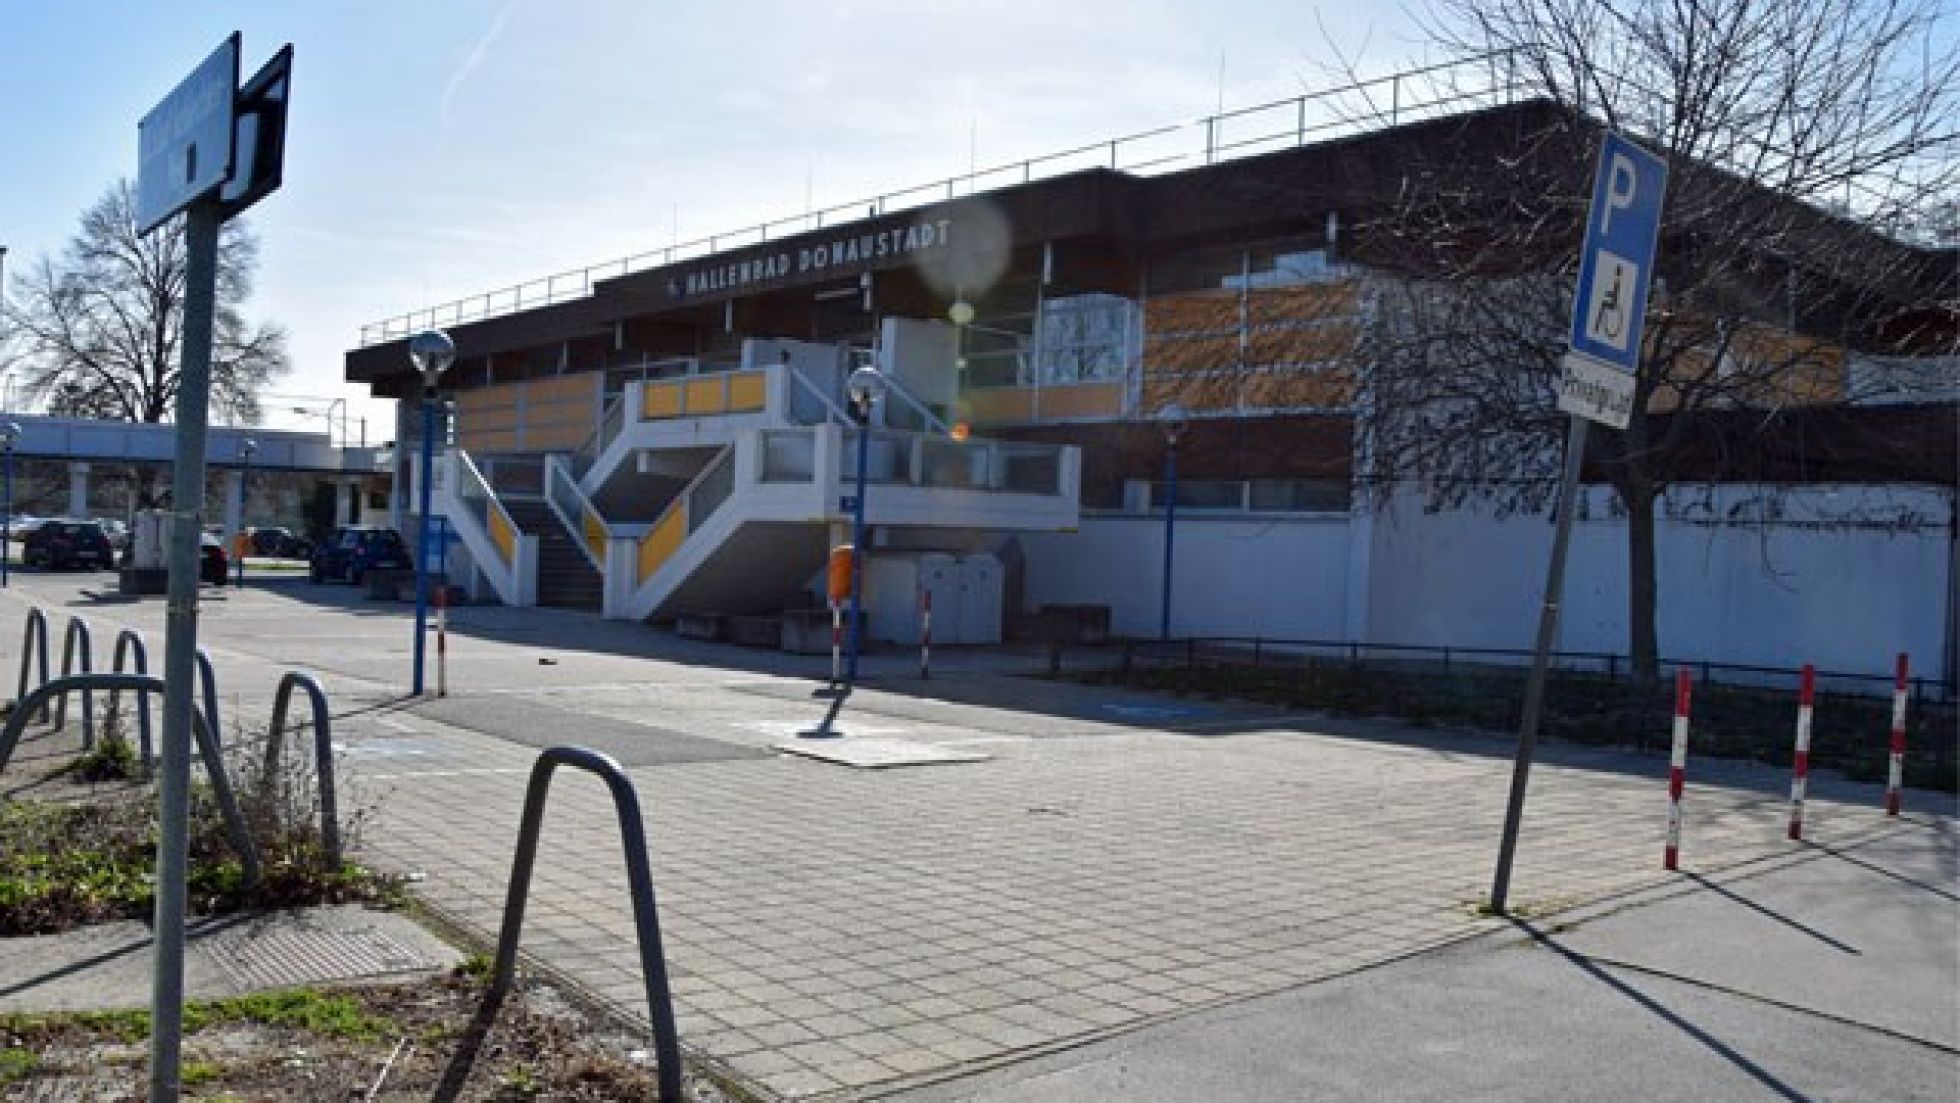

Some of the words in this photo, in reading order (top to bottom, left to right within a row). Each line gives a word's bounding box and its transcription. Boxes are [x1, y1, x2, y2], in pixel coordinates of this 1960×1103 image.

[1601, 152, 1636, 233] P
[686, 253, 789, 296] HALLENBAD
[799, 220, 950, 272] DONAUSTADT
